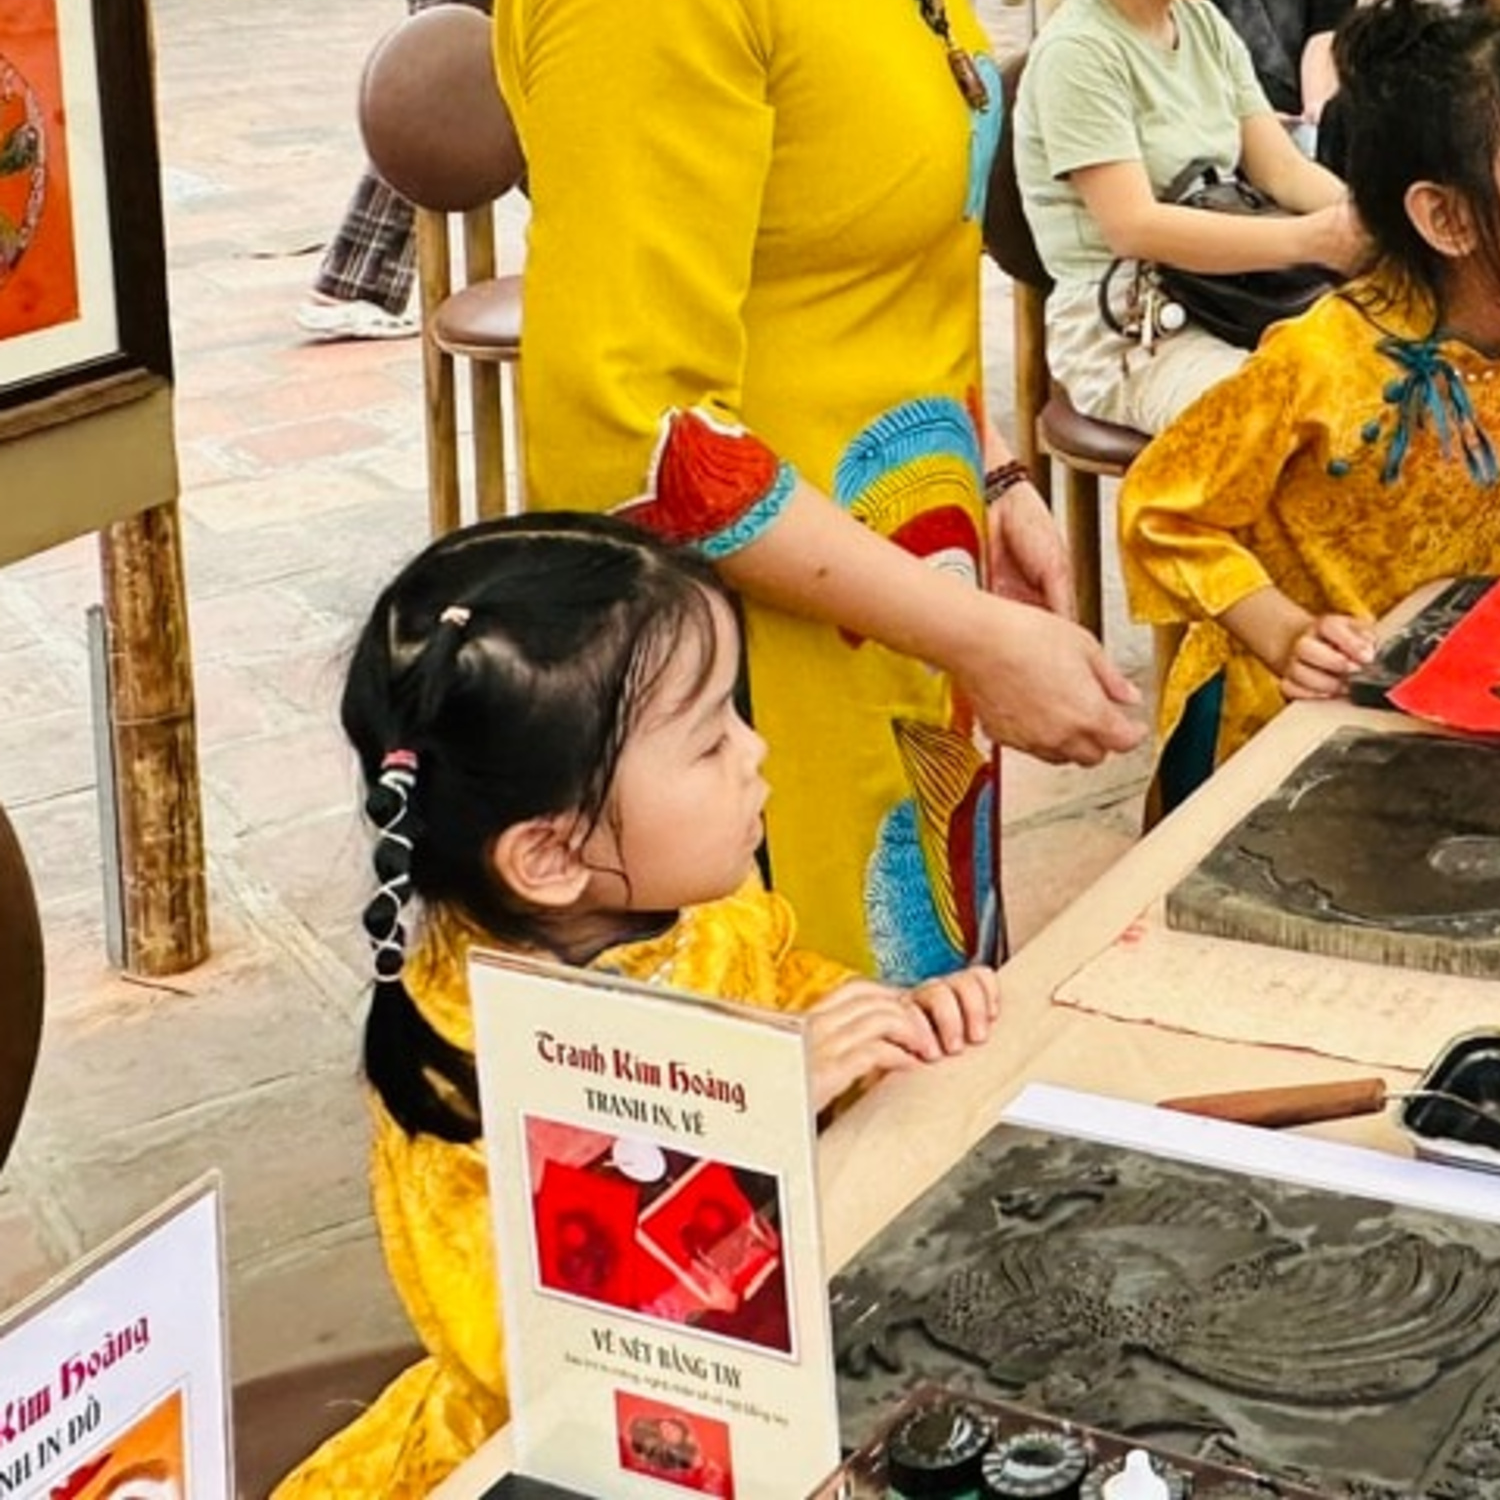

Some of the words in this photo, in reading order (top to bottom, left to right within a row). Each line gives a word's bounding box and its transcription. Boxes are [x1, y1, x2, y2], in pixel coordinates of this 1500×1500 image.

[535, 1031, 607, 1075] Tranh
[613, 1048, 661, 1087] Kim
[584, 1088, 648, 1123] TRANH
[59, 1317, 150, 1400] Hoàng
[711, 1361, 742, 1389] TAY
[38, 1428, 62, 1470] IN
